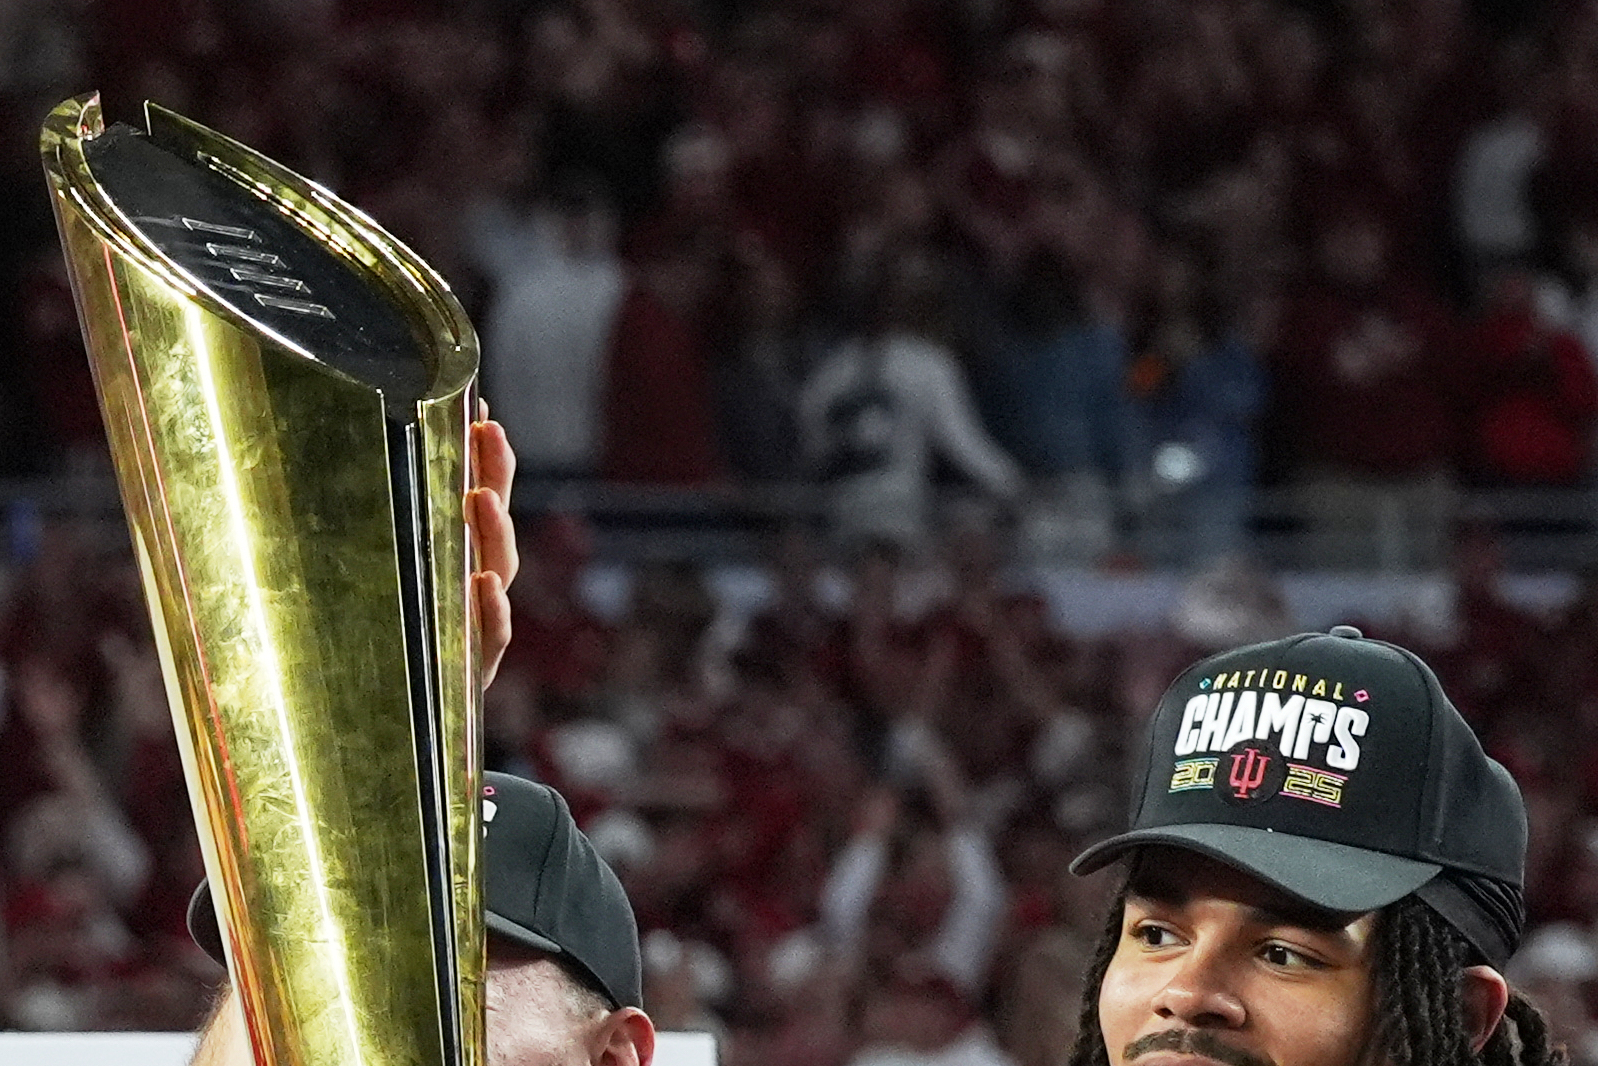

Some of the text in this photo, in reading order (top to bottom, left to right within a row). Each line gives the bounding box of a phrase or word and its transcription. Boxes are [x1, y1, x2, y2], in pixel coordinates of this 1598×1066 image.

[1213, 668, 1344, 701] NATIONAL
[1174, 690, 1370, 771] CHAMPS
[1170, 762, 1218, 789] 20
[1283, 766, 1345, 804] 25
